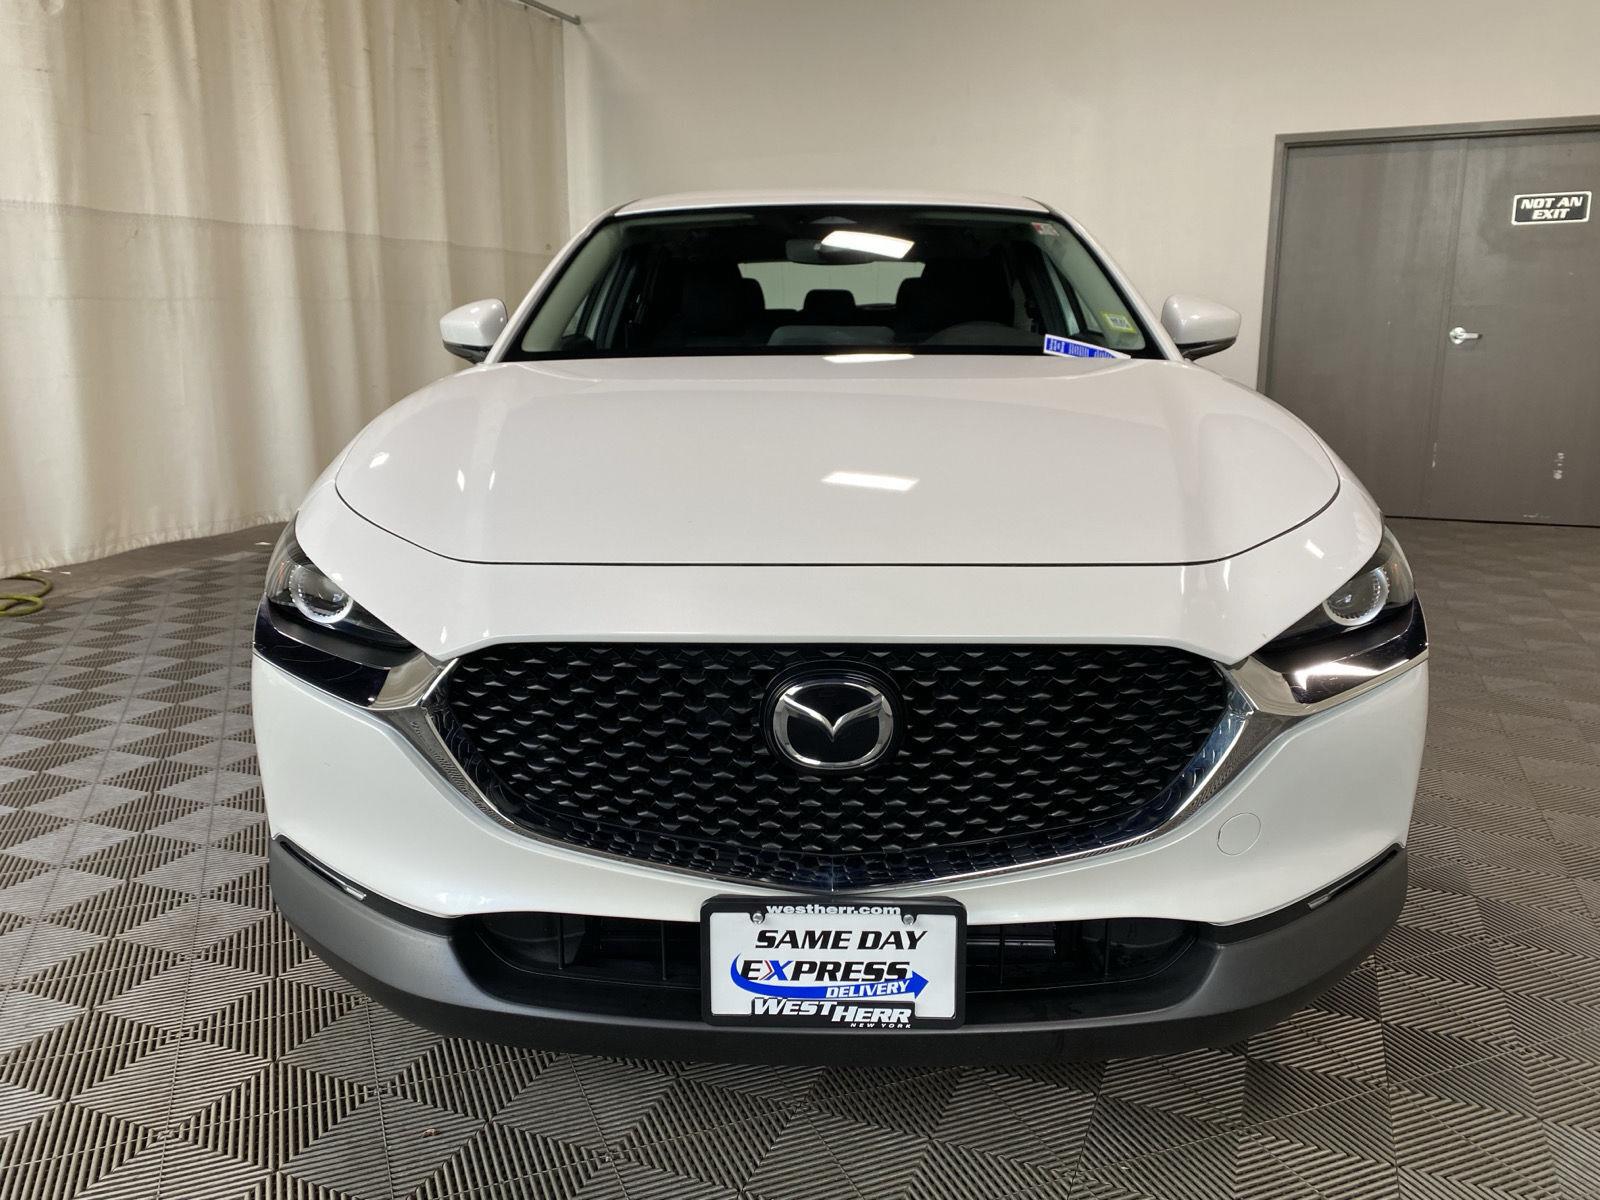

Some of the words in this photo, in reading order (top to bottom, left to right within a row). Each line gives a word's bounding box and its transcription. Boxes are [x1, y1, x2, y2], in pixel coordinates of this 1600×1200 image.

[1520, 198, 1555, 209] NOT
[1557, 196, 1583, 207] AN
[1532, 208, 1570, 220] EXIT
[766, 904, 901, 915] westherr.com
[755, 929, 852, 950] SAME
[857, 930, 928, 950] DAY
[739, 960, 910, 982] EXPRESS
[825, 980, 911, 999] DELIVERY
